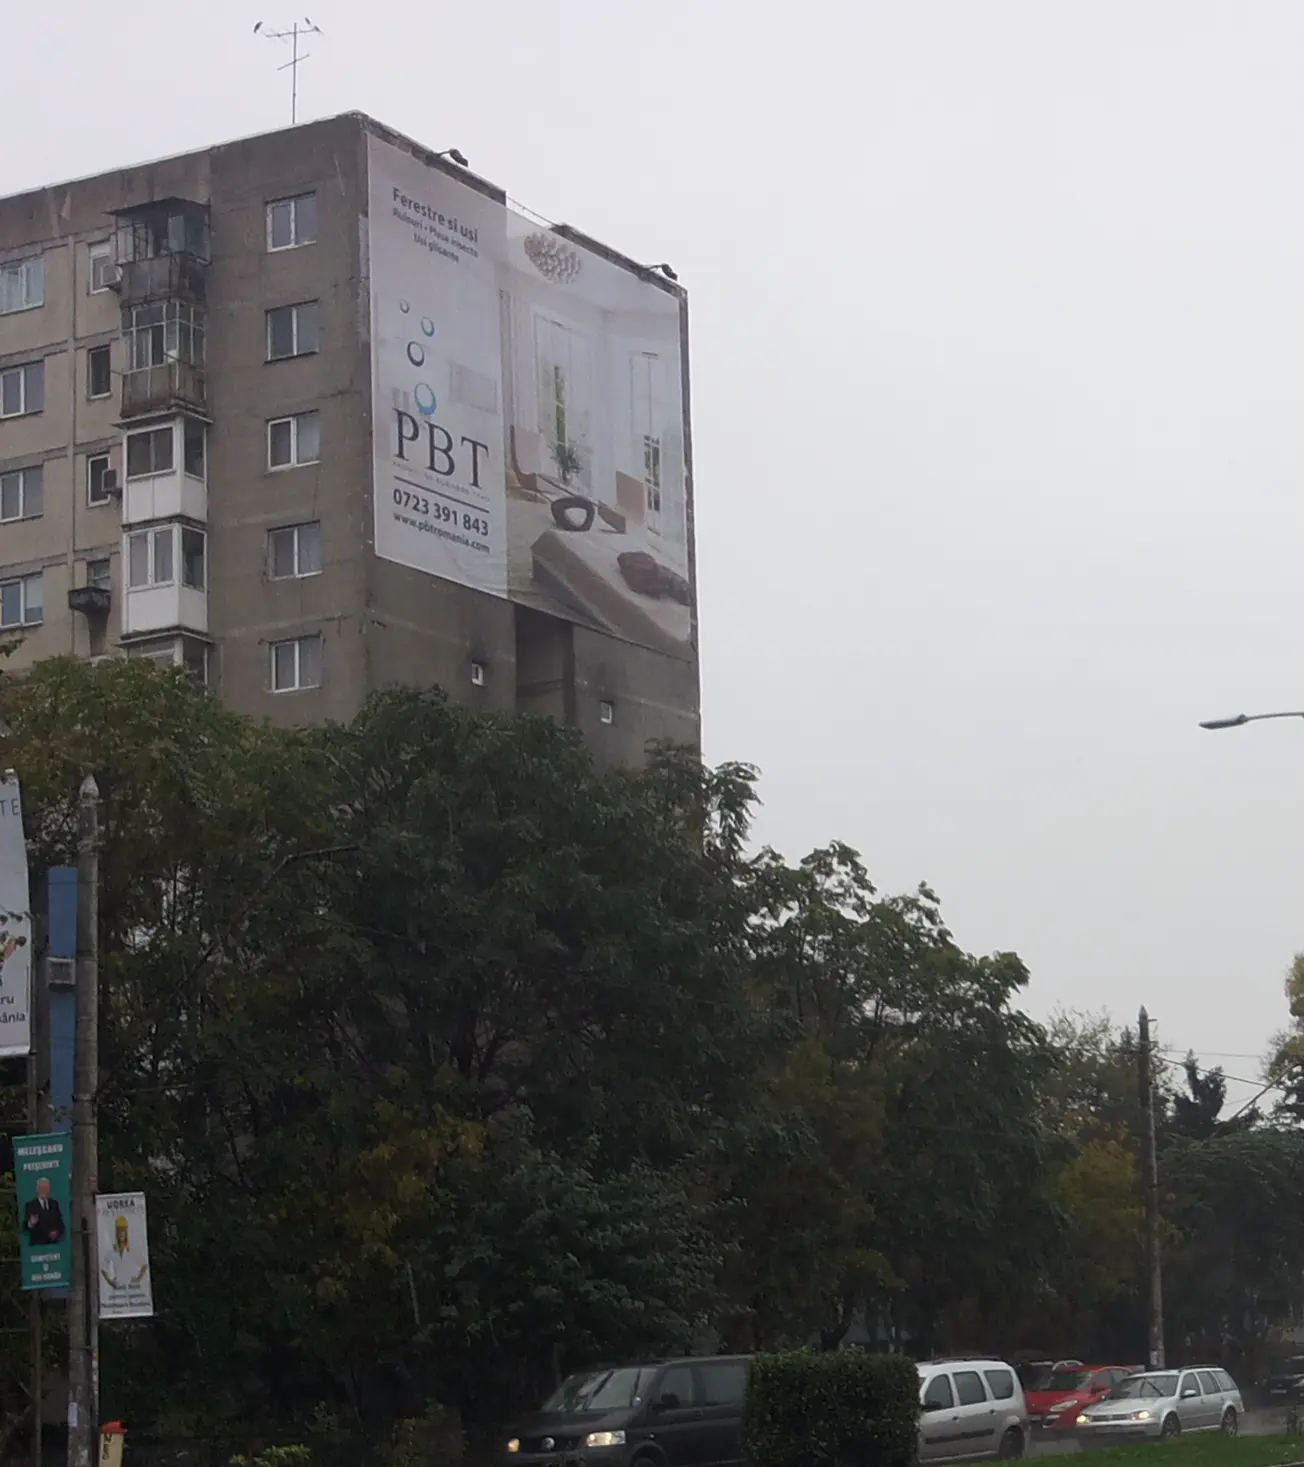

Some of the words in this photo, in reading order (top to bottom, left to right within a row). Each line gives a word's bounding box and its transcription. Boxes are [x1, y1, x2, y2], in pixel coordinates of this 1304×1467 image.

[393, 187, 445, 226] Ferestre
[460, 225, 478, 243] usi
[392, 407, 489, 490] PBT
[393, 488, 429, 515] 0723
[433, 503, 458, 526] 391
[463, 513, 489, 536] 843
[393, 512, 490, 553] www.pbtromania.com
[0, 1011, 26, 1024] ânia
